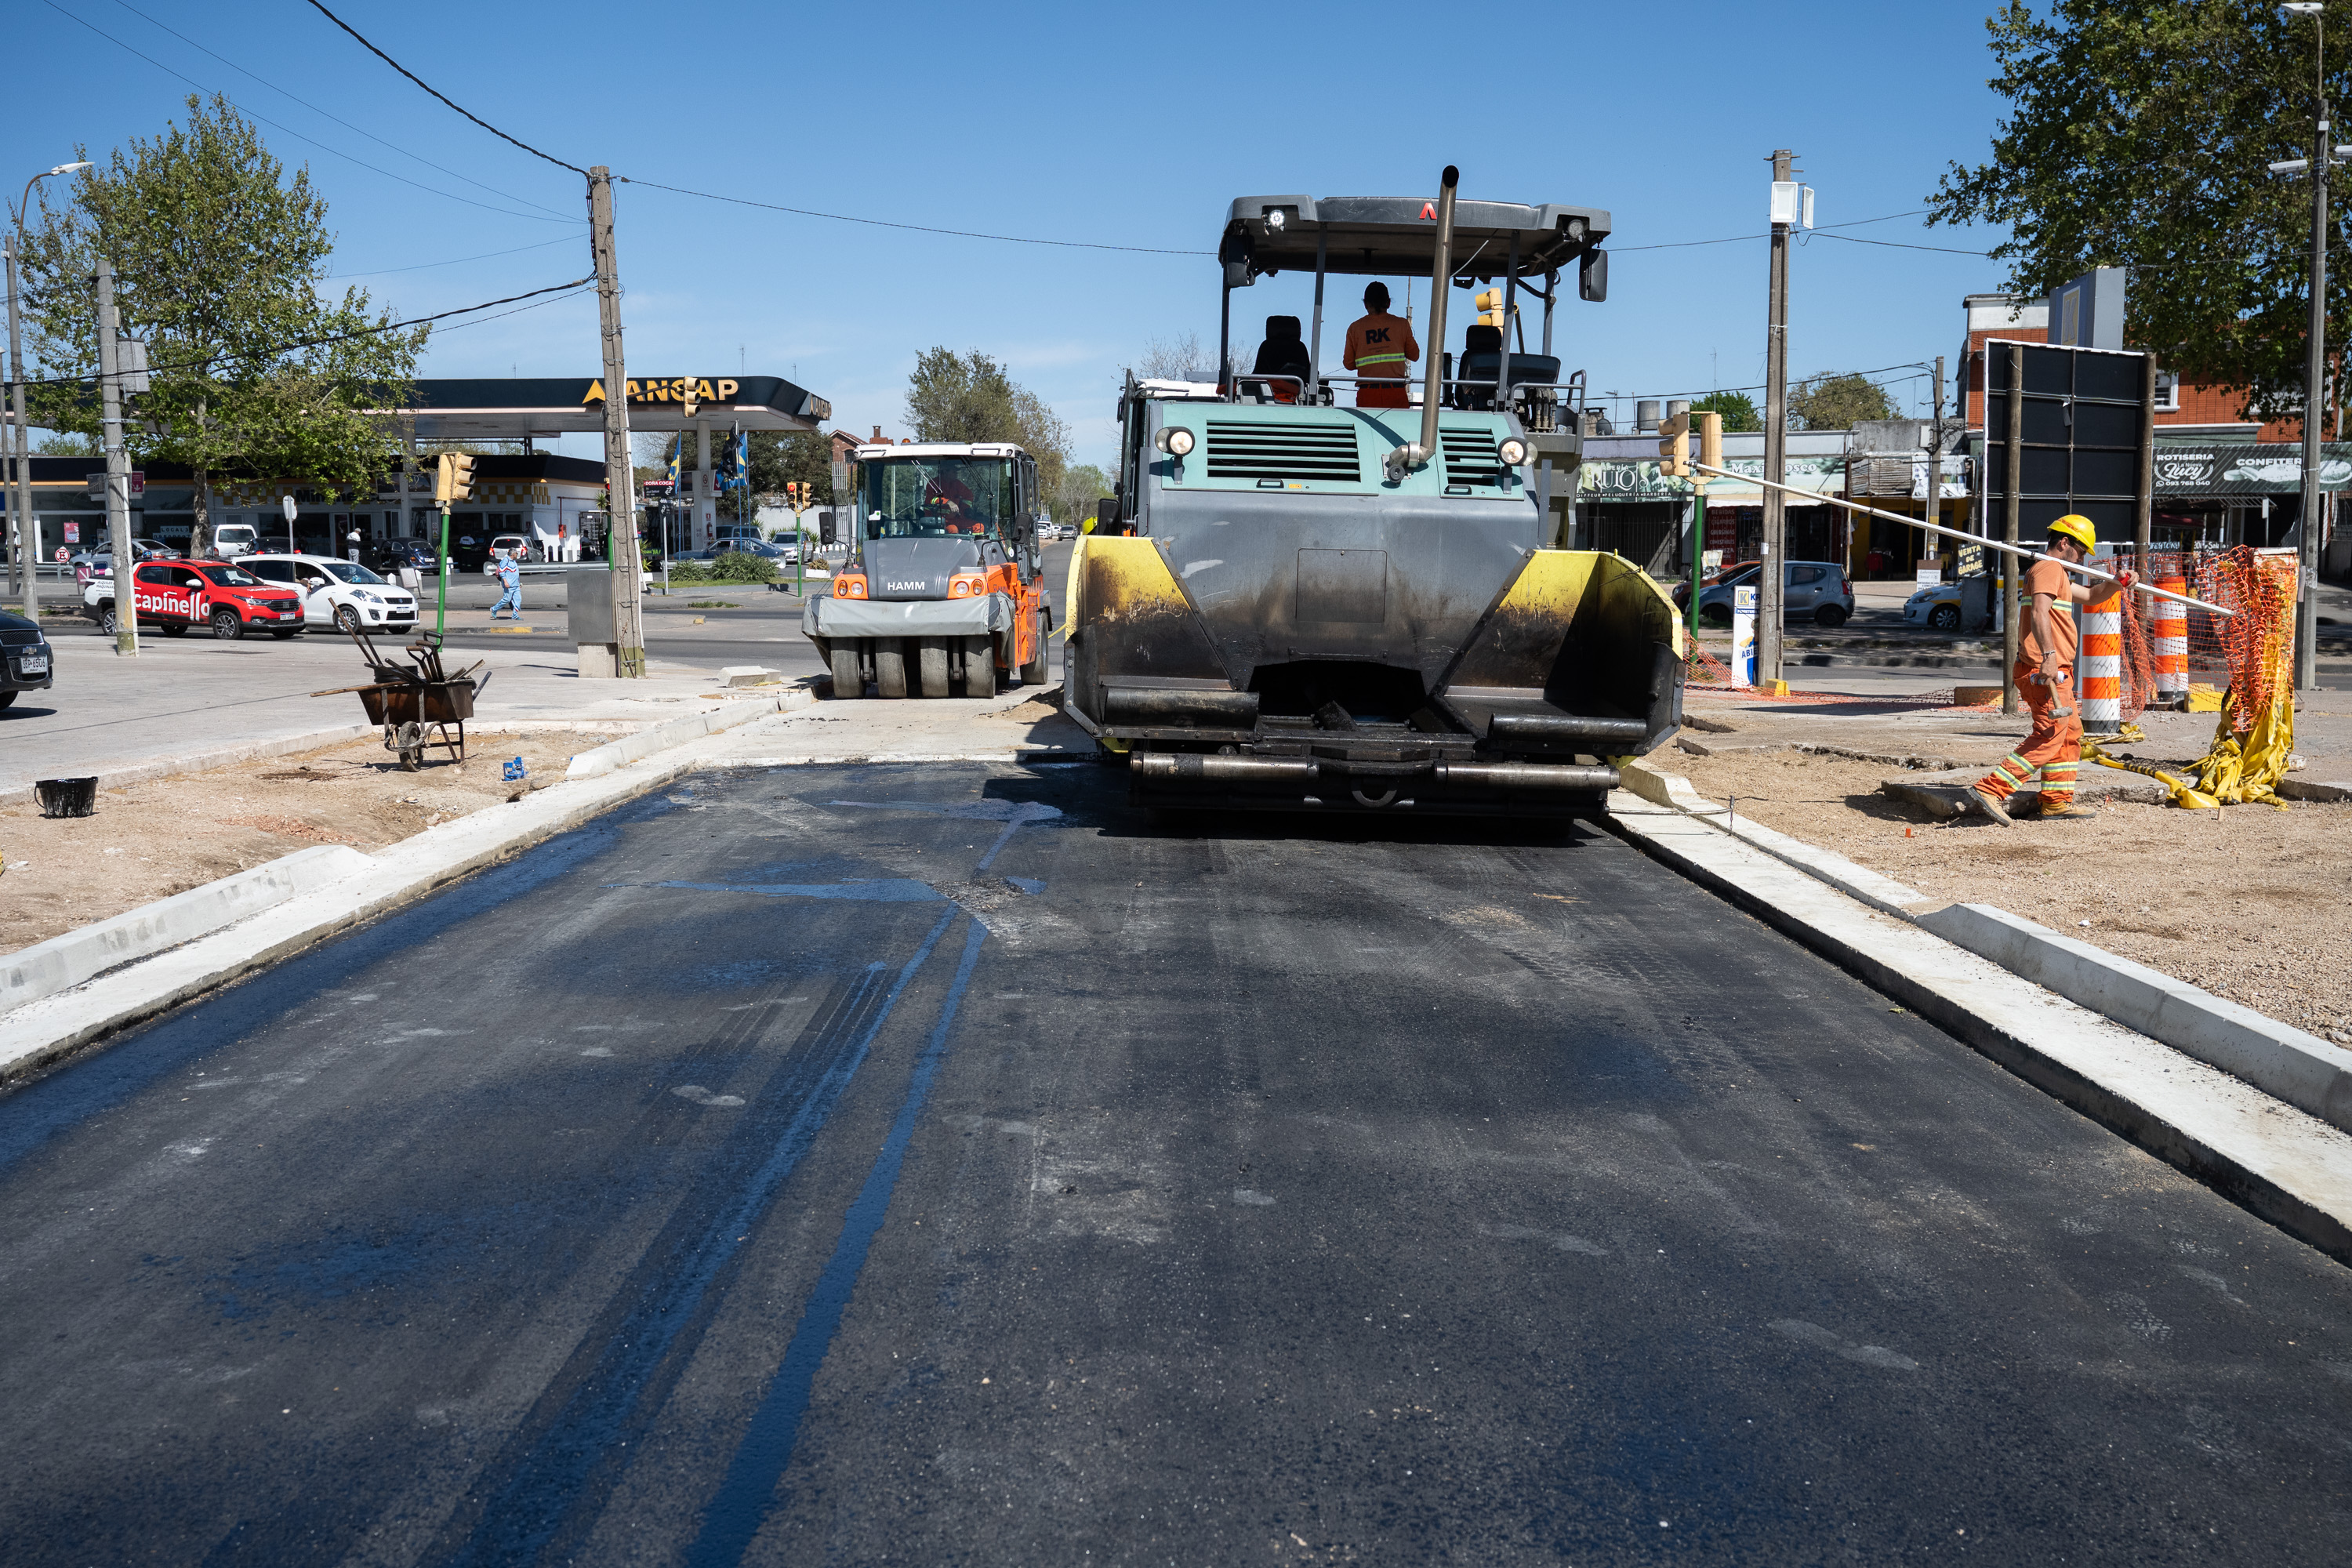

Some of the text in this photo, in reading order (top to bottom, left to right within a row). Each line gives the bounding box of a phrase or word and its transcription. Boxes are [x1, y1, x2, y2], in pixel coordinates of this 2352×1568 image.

[1366, 328, 1391, 344] RK
[1785, 463, 1817, 473] osco
[2164, 463, 2204, 480] Lucy
[1958, 545, 1982, 557] VENTA
[1958, 560, 1983, 575] GARAGE
[887, 582, 925, 591] HAMM
[1741, 648, 1759, 659] ABIE
